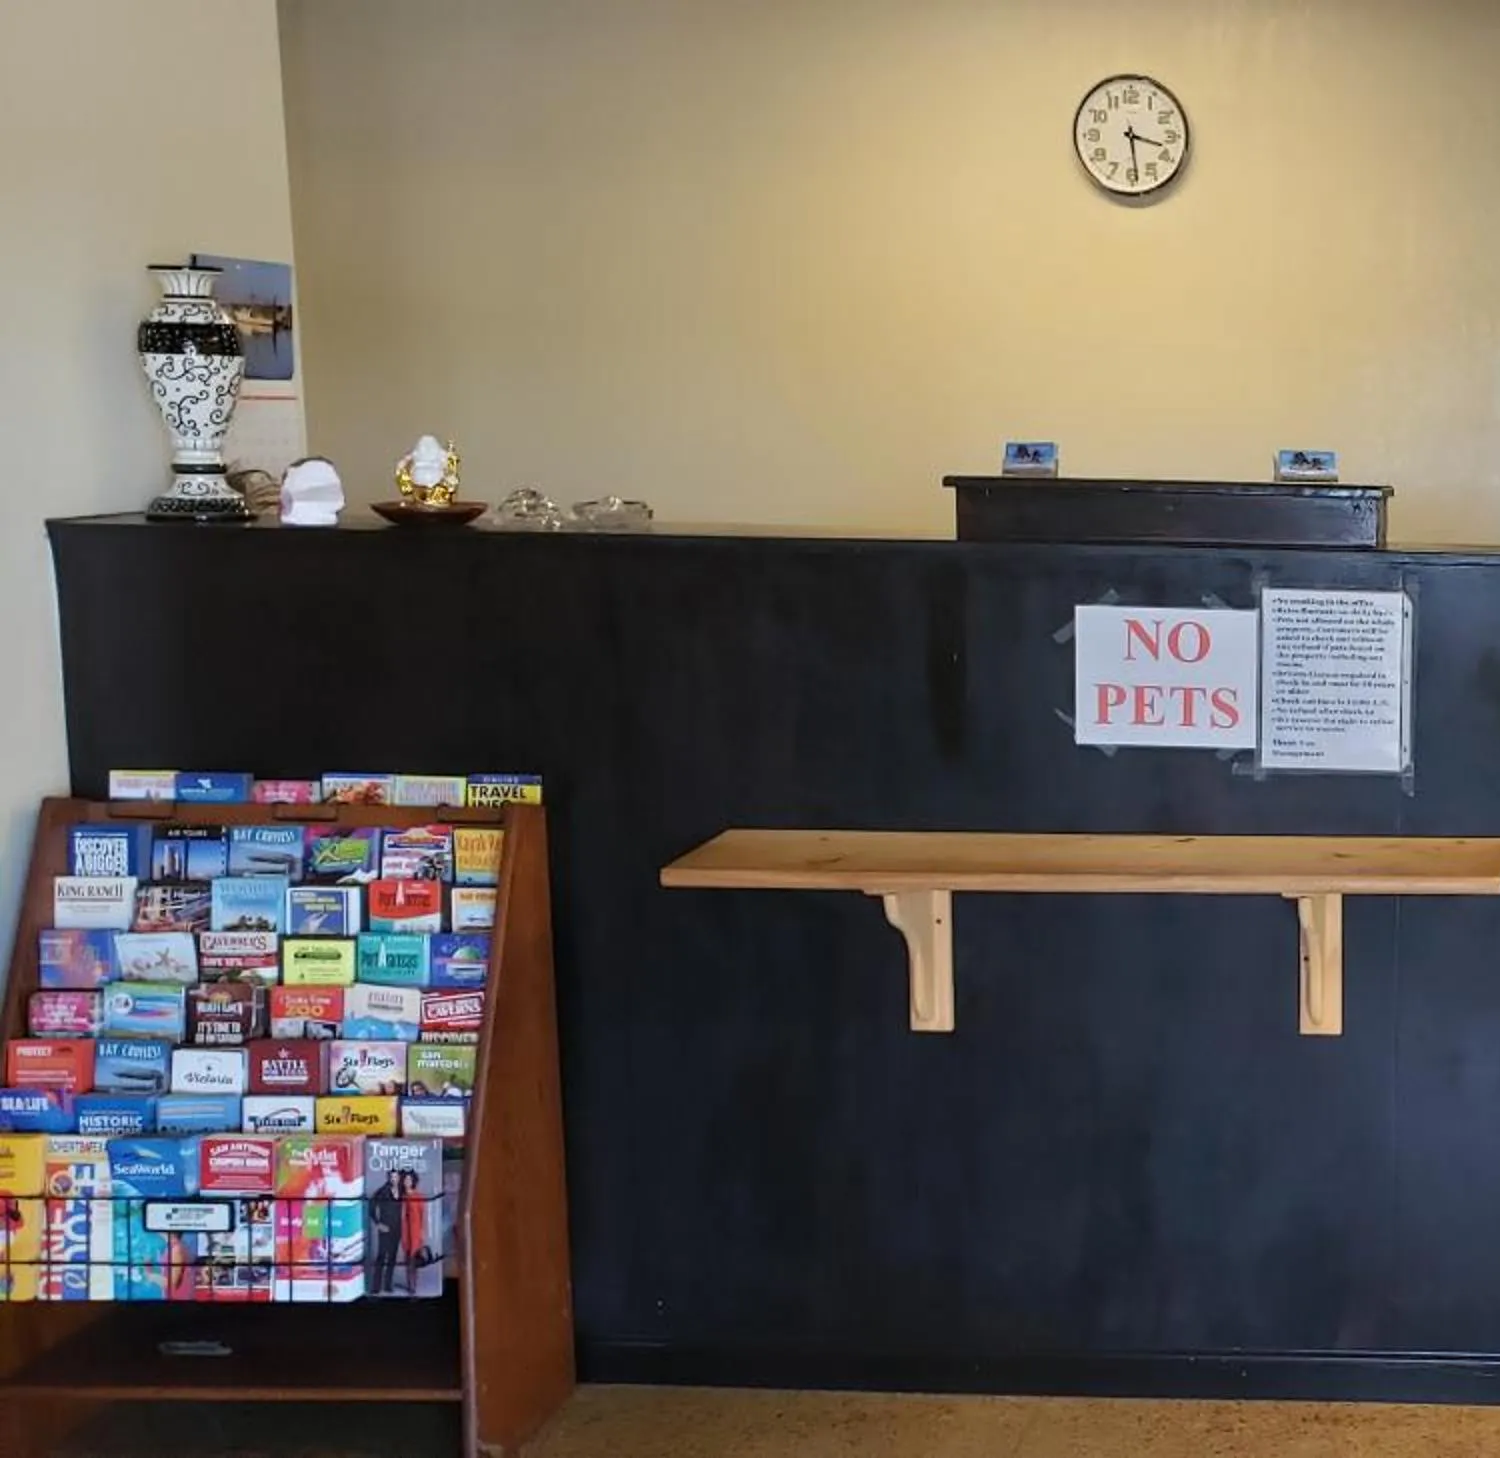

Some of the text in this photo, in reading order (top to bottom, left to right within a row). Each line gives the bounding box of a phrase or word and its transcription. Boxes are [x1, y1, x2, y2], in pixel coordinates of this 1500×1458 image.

[1123, 90, 1140, 105] 12
[1147, 95, 1153, 111] 1
[1088, 109, 1108, 123] 10
[1157, 110, 1171, 125] 2
[1087, 128, 1101, 142] 9
[1164, 129, 1178, 144] 3
[1094, 147, 1107, 161] 8
[1157, 148, 1172, 162] 4
[1108, 162, 1120, 176] 7
[1144, 162, 1158, 177] 5
[1123, 619, 1212, 663] NO
[1093, 683, 1240, 729] PETS
[471, 785, 527, 799] TRAVEL
[76, 838, 128, 855] DISCOVER
[57, 883, 123, 898] KING RANCH
[285, 1004, 325, 1017] ZOO
[99, 1045, 118, 1057] BAY
[343, 1056, 394, 1069] Six Flags
[80, 1115, 144, 1128] HISTORIC
[324, 1114, 379, 1125] Six Flags
[369, 1141, 428, 1159] Tanger
[113, 1163, 176, 1177] SeaWorld
[369, 1156, 428, 1172] Outlets
